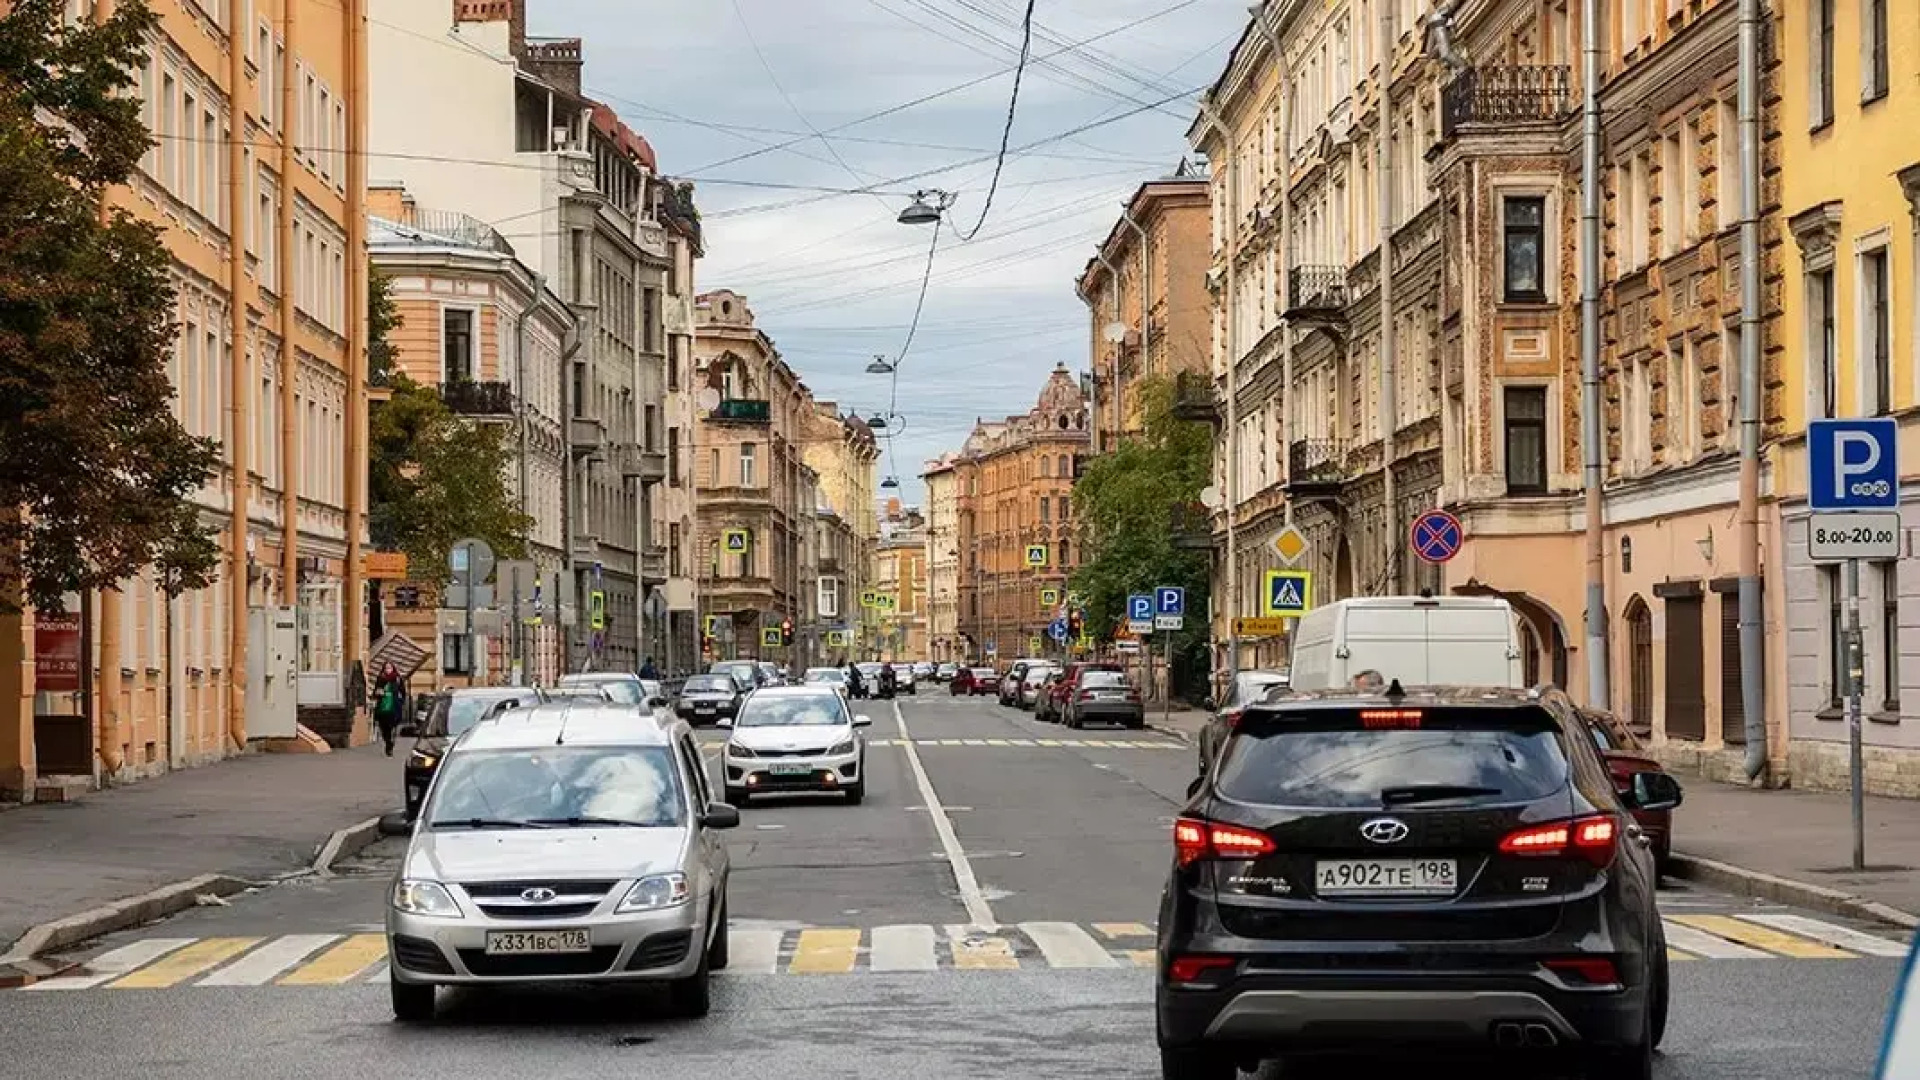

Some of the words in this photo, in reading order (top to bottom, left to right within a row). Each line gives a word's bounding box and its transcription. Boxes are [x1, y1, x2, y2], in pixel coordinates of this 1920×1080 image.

[1834, 430, 1880, 499] P
[1816, 528, 1893, 543] 8.00-20.00
[36, 621, 78, 631] РОДУКТЫ
